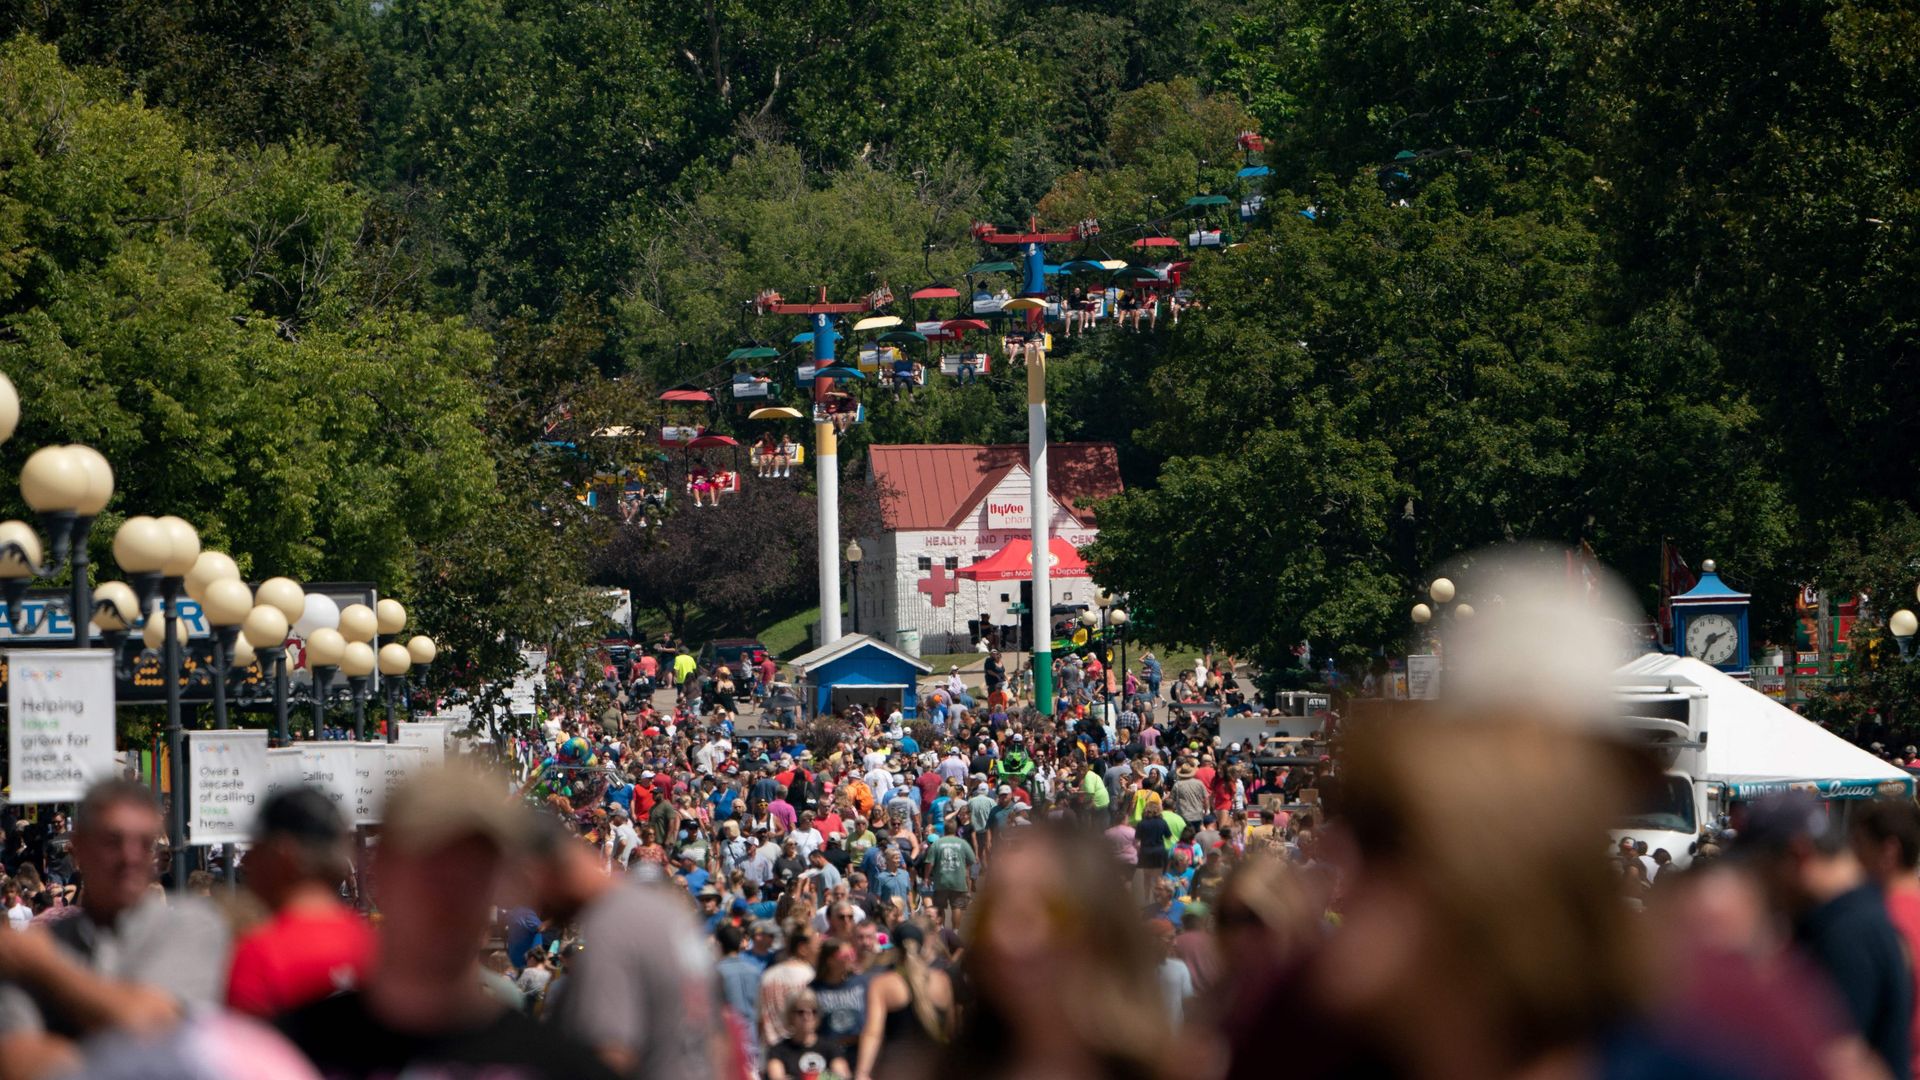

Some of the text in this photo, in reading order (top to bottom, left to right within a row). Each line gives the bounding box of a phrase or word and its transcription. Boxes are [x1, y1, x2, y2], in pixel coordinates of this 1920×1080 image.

[818, 313, 826, 327] 3
[925, 535, 967, 547] HEALTH
[974, 534, 997, 545] AND
[1015, 569, 1032, 577] Moin
[21, 699, 84, 716] Helping
[1308, 698, 1327, 706] ATM
[201, 767, 240, 776] Over a
[1738, 783, 1772, 800] MADE
[215, 792, 256, 805] calling
